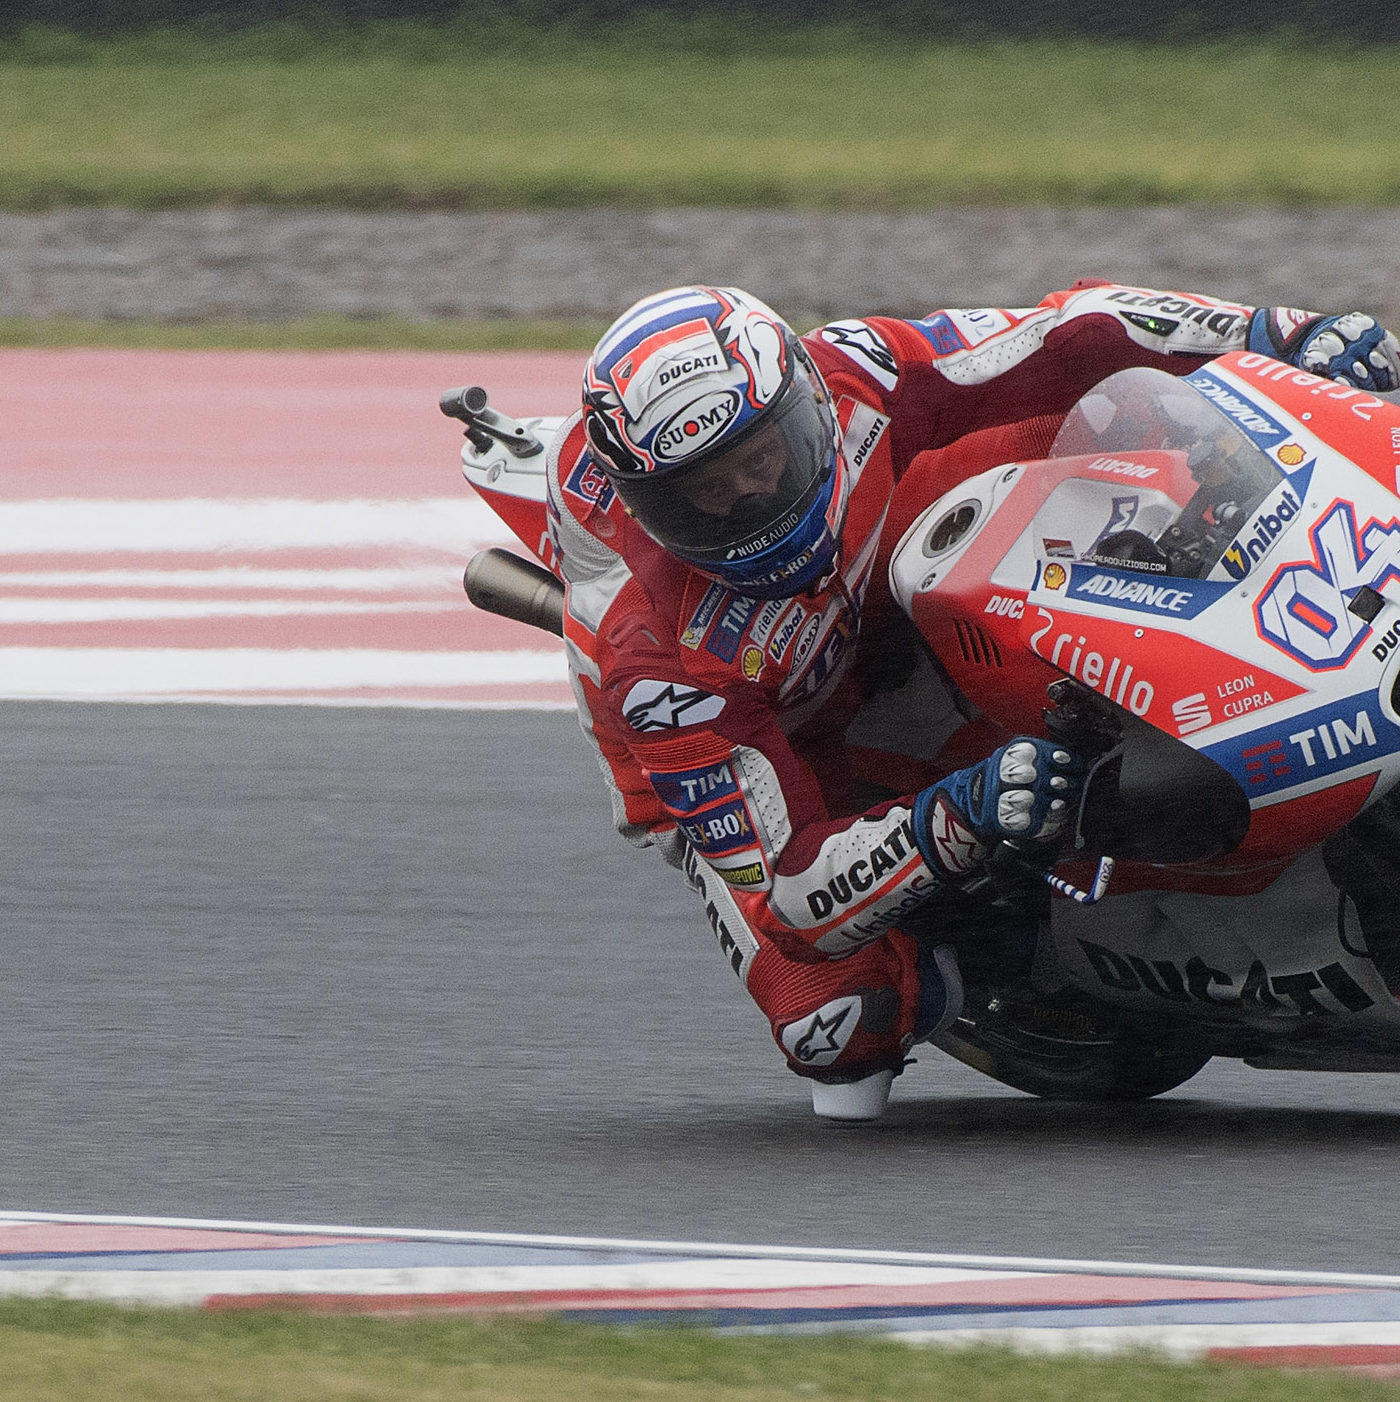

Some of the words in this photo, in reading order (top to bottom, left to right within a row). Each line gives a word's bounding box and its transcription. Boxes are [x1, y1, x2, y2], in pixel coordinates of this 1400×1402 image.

[1105, 291, 1240, 337] DUCATI
[659, 355, 718, 385] DUCATI
[658, 398, 735, 450] SUOMY
[1194, 378, 1280, 435] ADVANCE
[853, 417, 884, 467] DUCATI
[1087, 457, 1159, 479] DUCATI
[1220, 489, 1301, 580] Unibat
[721, 596, 756, 634] TIM
[1076, 574, 1193, 612] ADVANCE
[770, 607, 803, 660] Unibat
[1216, 674, 1256, 699] LEON
[1223, 690, 1274, 718] CUPRA
[1289, 710, 1377, 767] TIM
[680, 762, 733, 802] TIM
[685, 807, 749, 845] EX-BOX
[806, 815, 918, 922] DUCATI
[1076, 937, 1376, 1014] DUCATI
